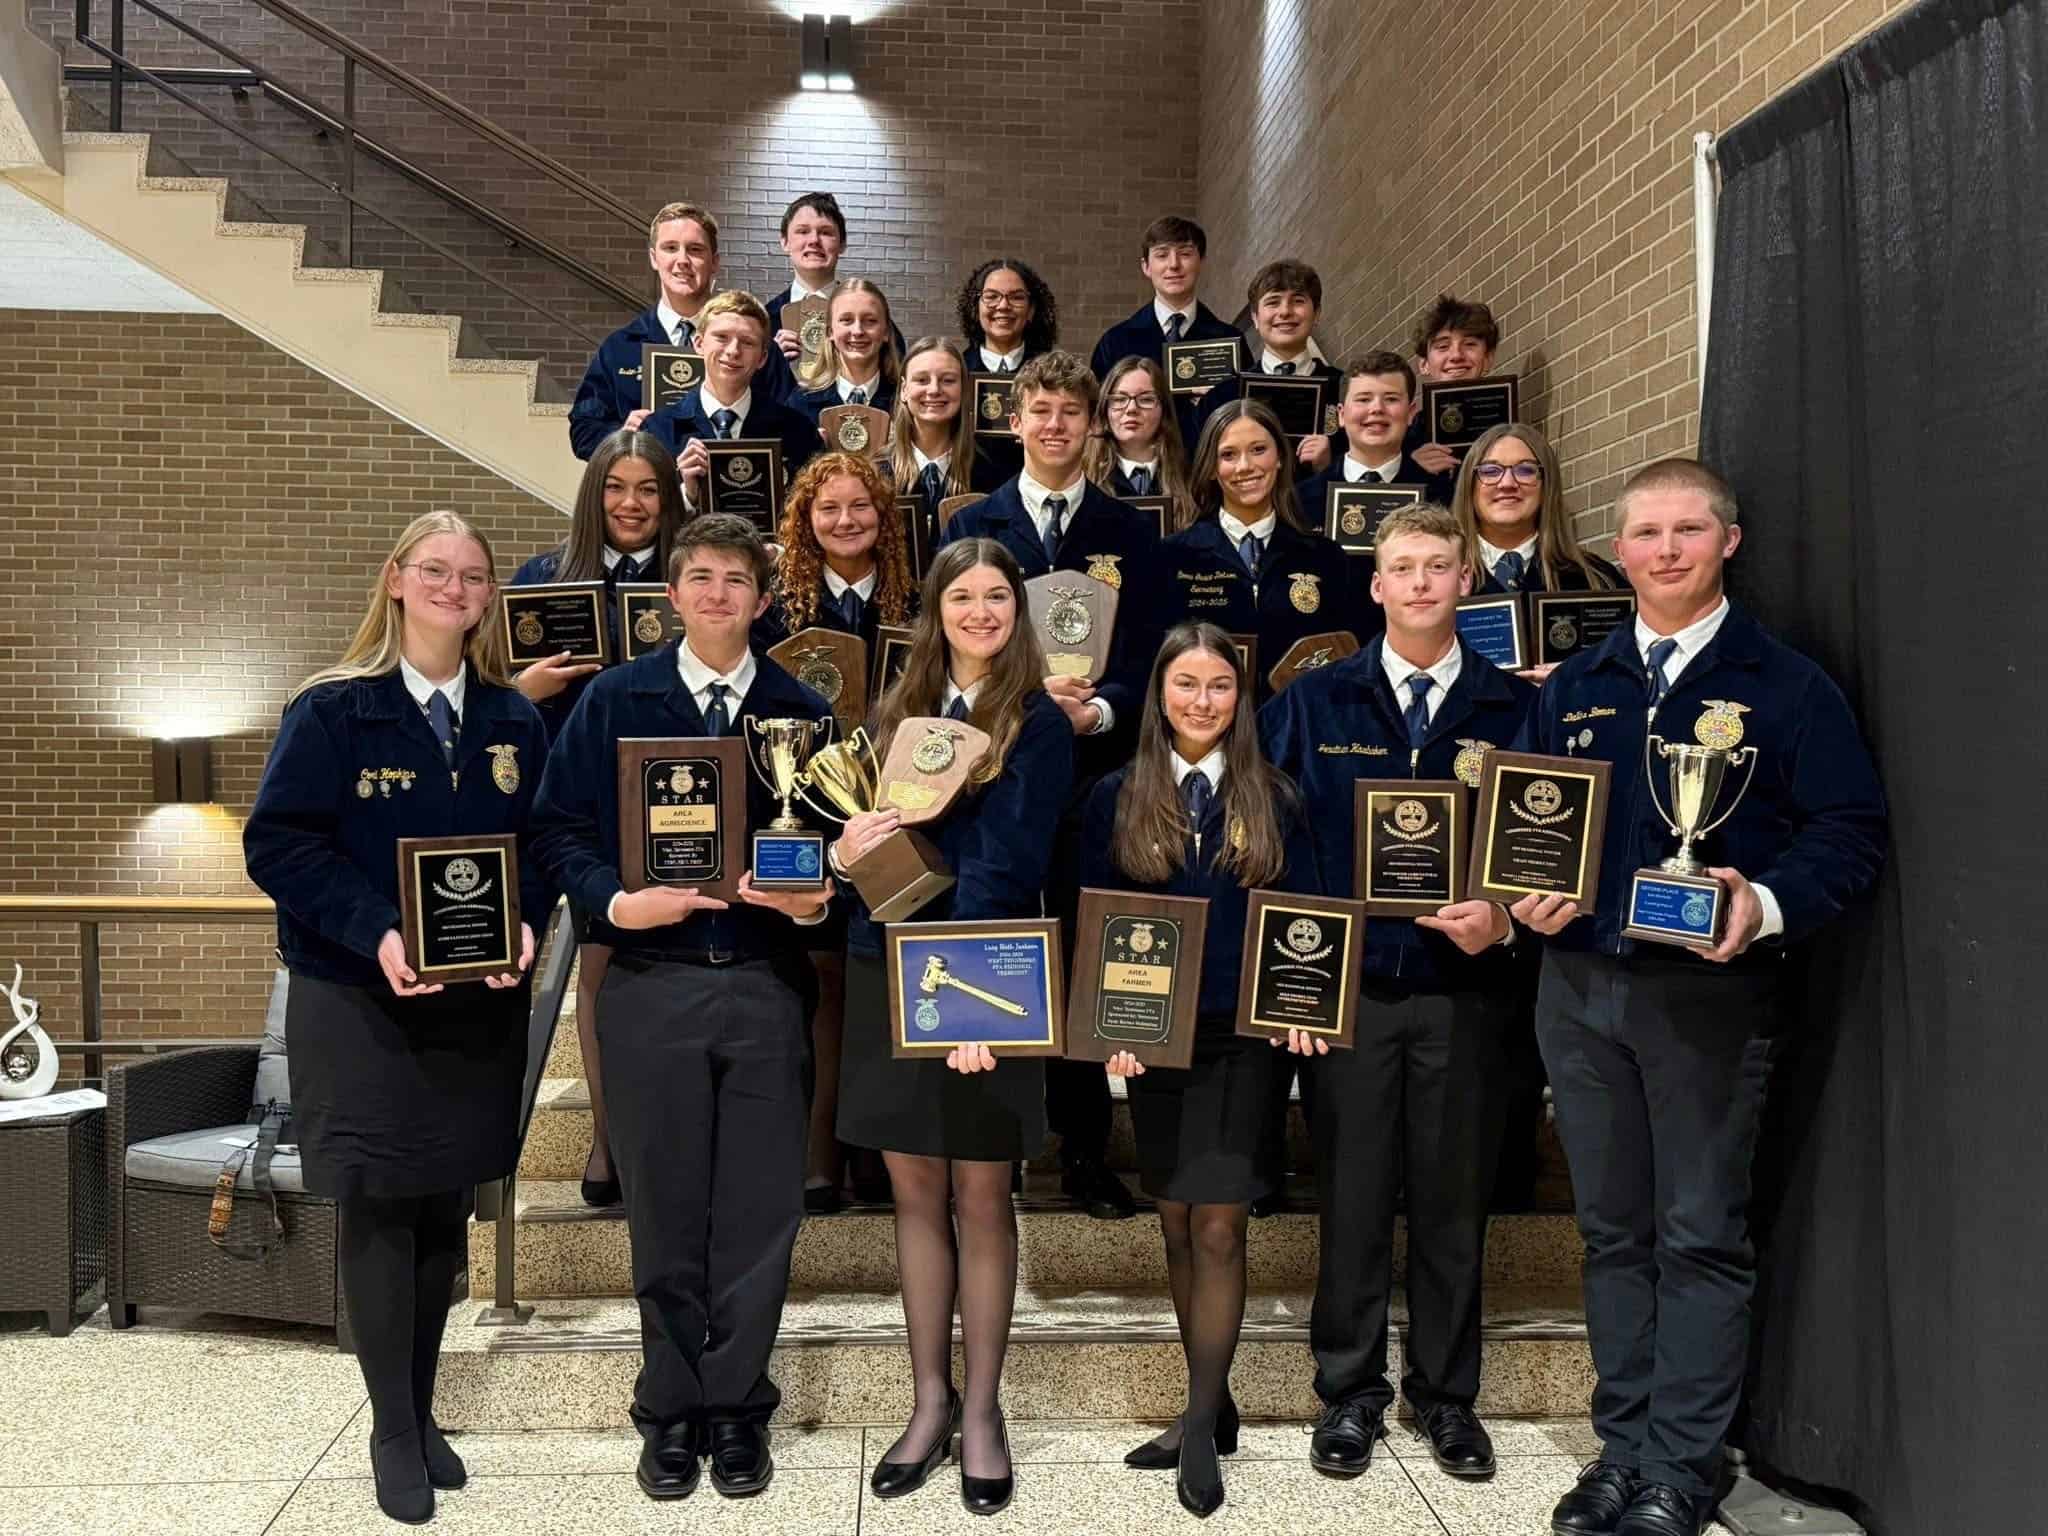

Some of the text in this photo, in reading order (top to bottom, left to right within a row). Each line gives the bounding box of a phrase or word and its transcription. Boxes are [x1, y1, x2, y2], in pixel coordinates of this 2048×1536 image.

[661, 794, 704, 804] STAR
[1118, 952, 1160, 965] STAR
[1127, 968, 1148, 977] AREA
